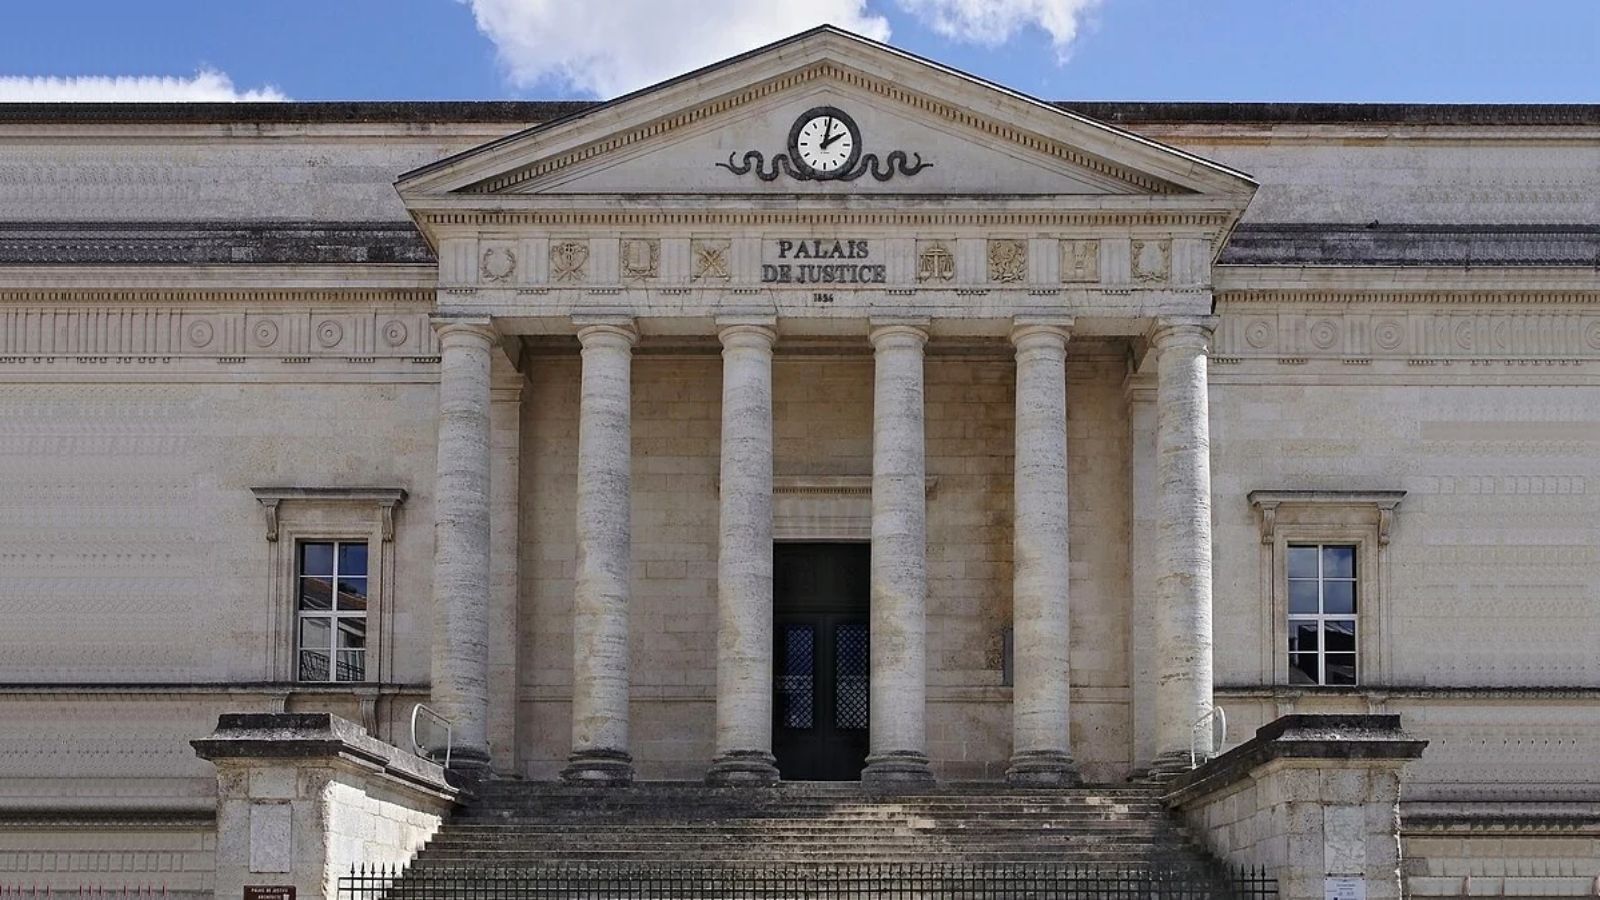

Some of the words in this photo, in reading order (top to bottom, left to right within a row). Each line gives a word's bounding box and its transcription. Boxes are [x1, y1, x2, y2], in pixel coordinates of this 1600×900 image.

[778, 240, 869, 259] PALAIS
[761, 264, 792, 283] DE
[796, 264, 887, 284] JUSTICE
